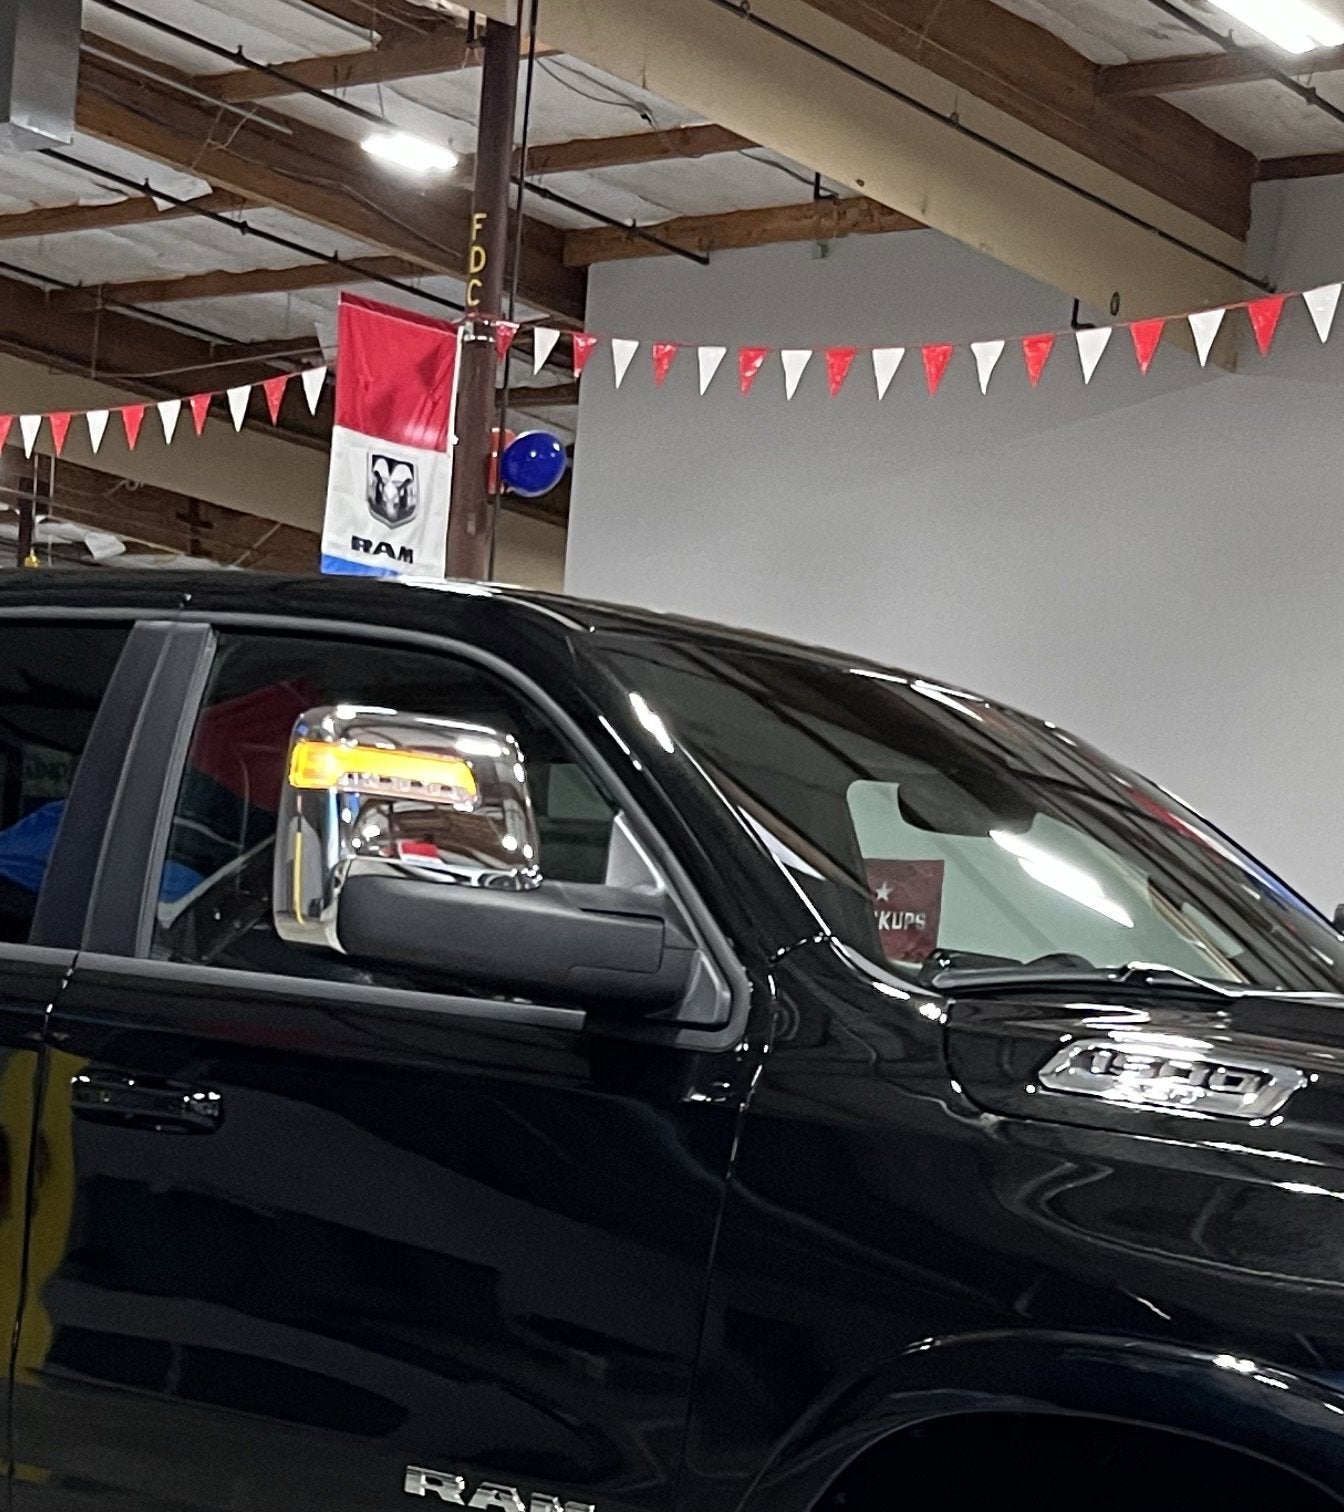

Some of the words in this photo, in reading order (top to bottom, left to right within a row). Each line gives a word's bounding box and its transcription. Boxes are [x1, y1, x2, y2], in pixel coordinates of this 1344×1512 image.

[465, 213, 487, 306] FDC
[352, 536, 414, 565] RAM
[874, 910, 927, 931] KUPS
